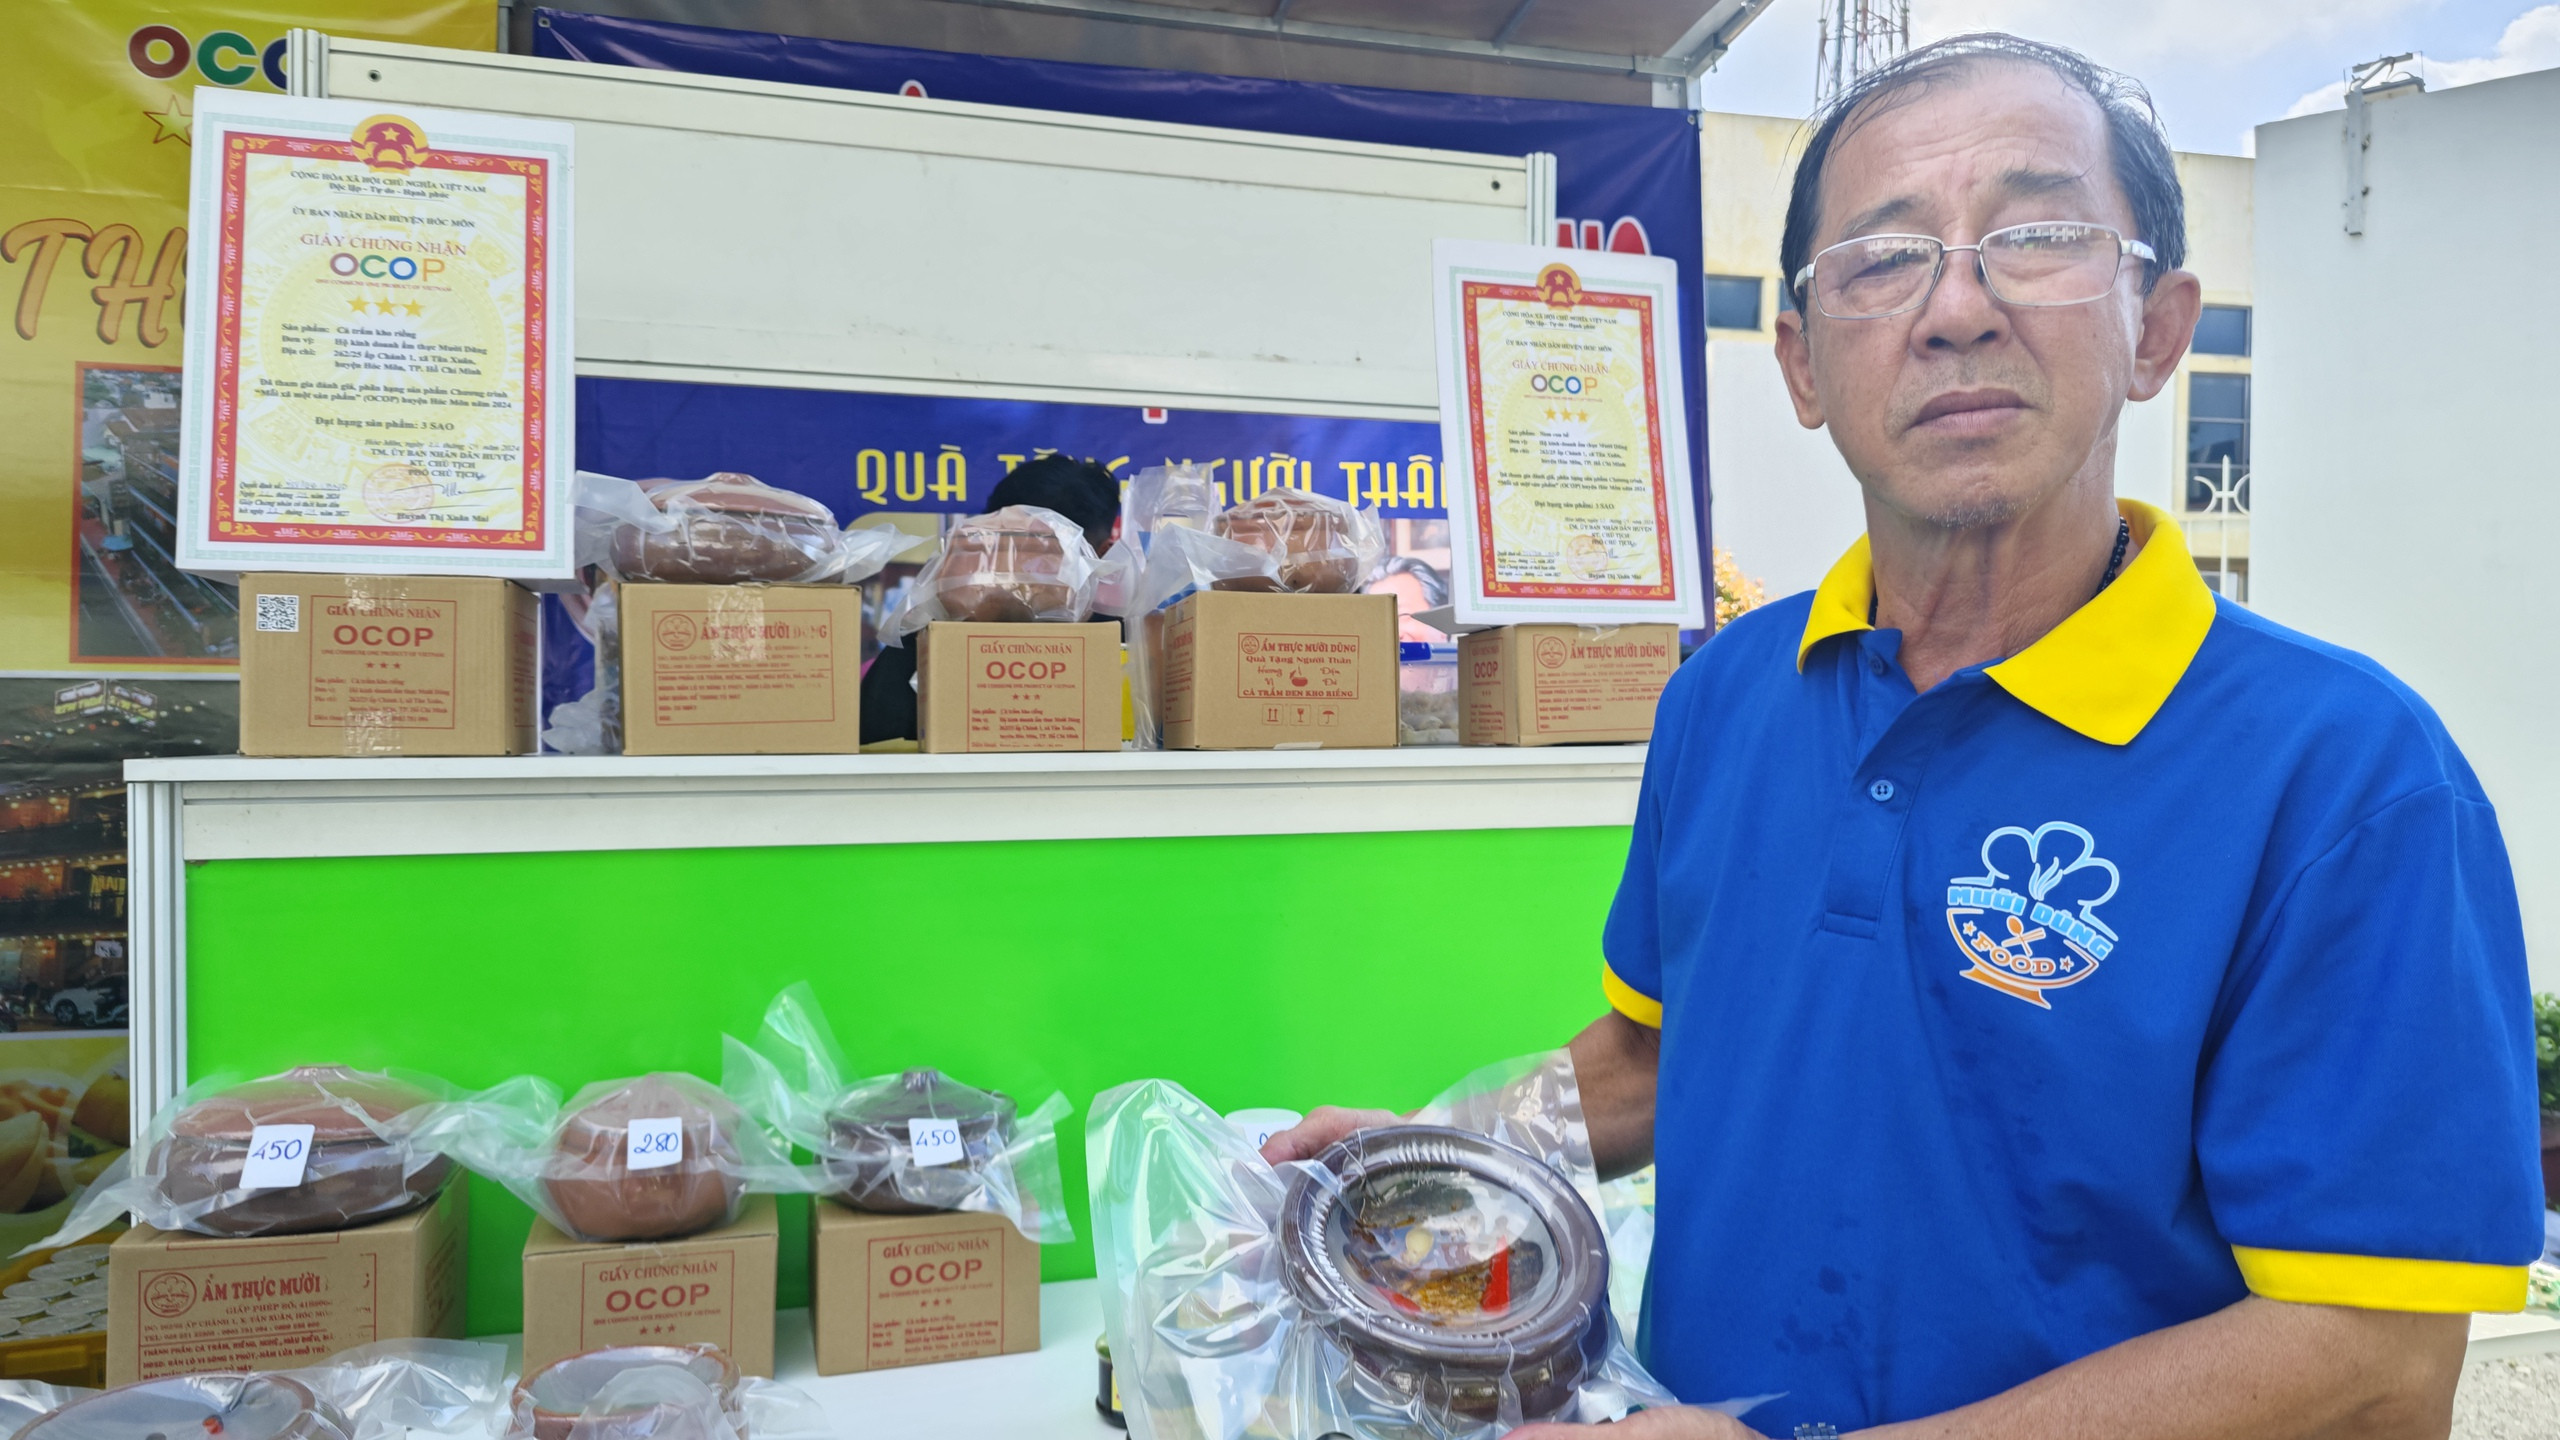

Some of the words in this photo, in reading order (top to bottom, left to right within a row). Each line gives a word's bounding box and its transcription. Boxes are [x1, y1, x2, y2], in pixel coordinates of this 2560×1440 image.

[300, 231, 345, 248] GIẤY
[350, 235, 413, 253] CHỨNG
[417, 240, 468, 258] NHẬN
[329, 252, 447, 282] OCOP
[0, 217, 188, 348] TH
[1531, 374, 1598, 396] OCOP
[421, 421, 428, 431] 3
[856, 444, 968, 506] QUÀ
[1338, 453, 1447, 509] THÂ
[327, 602, 356, 618] GIẤY
[407, 606, 441, 621] NHẬN
[333, 623, 435, 648] OCOP
[1278, 641, 1304, 655] THỰC
[1305, 641, 1329, 653] MƯỜI
[1331, 642, 1357, 654] DŨNG
[980, 640, 1005, 655] GIẤY
[1007, 642, 1042, 655] CHỨNG
[1044, 642, 1073, 657] NHẬN
[1570, 639, 1585, 664] ẨM
[1586, 644, 1612, 665] THỰC
[1613, 641, 1639, 661] MƯỜI
[1639, 640, 1666, 660] DŨNG
[986, 660, 1066, 680] OCOP
[1473, 660, 1499, 679] OCOP
[1948, 886, 2027, 916] MƯỜI
[2030, 902, 2114, 961] DŨNG
[1971, 931, 2057, 977] FOOD
[251, 1138, 303, 1161] 450
[632, 1131, 679, 1156] 280
[915, 1128, 957, 1148] 450
[883, 1241, 912, 1259] GIẤY
[914, 1241, 955, 1256] CHỨNG
[957, 1237, 990, 1252] NHẬN
[598, 1264, 631, 1283] GIẤY
[634, 1264, 680, 1280] CHỨNG
[682, 1259, 719, 1276] NHẬN
[889, 1258, 983, 1289] OCOP
[202, 1273, 228, 1302] ẨM
[231, 1275, 276, 1302] THỰC
[279, 1271, 321, 1296] MƯỜI
[605, 1282, 711, 1314] OCOP
